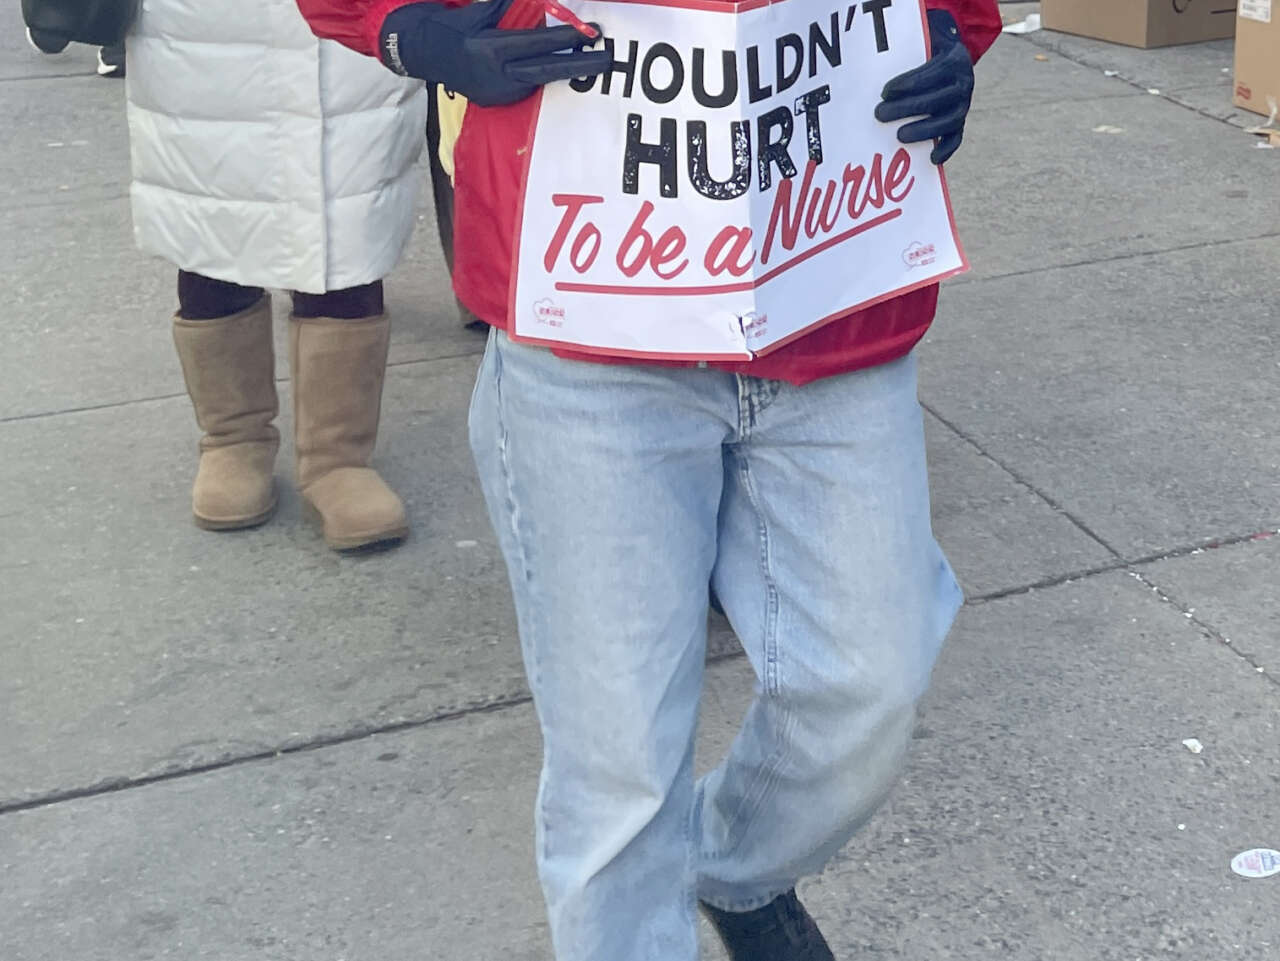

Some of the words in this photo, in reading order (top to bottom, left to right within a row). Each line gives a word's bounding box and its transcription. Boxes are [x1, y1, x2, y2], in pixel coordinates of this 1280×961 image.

[622, 84, 831, 201] HURT
[543, 193, 604, 274] To
[615, 201, 688, 280] be
[703, 226, 757, 278] a
[760, 147, 916, 264] Nurse
